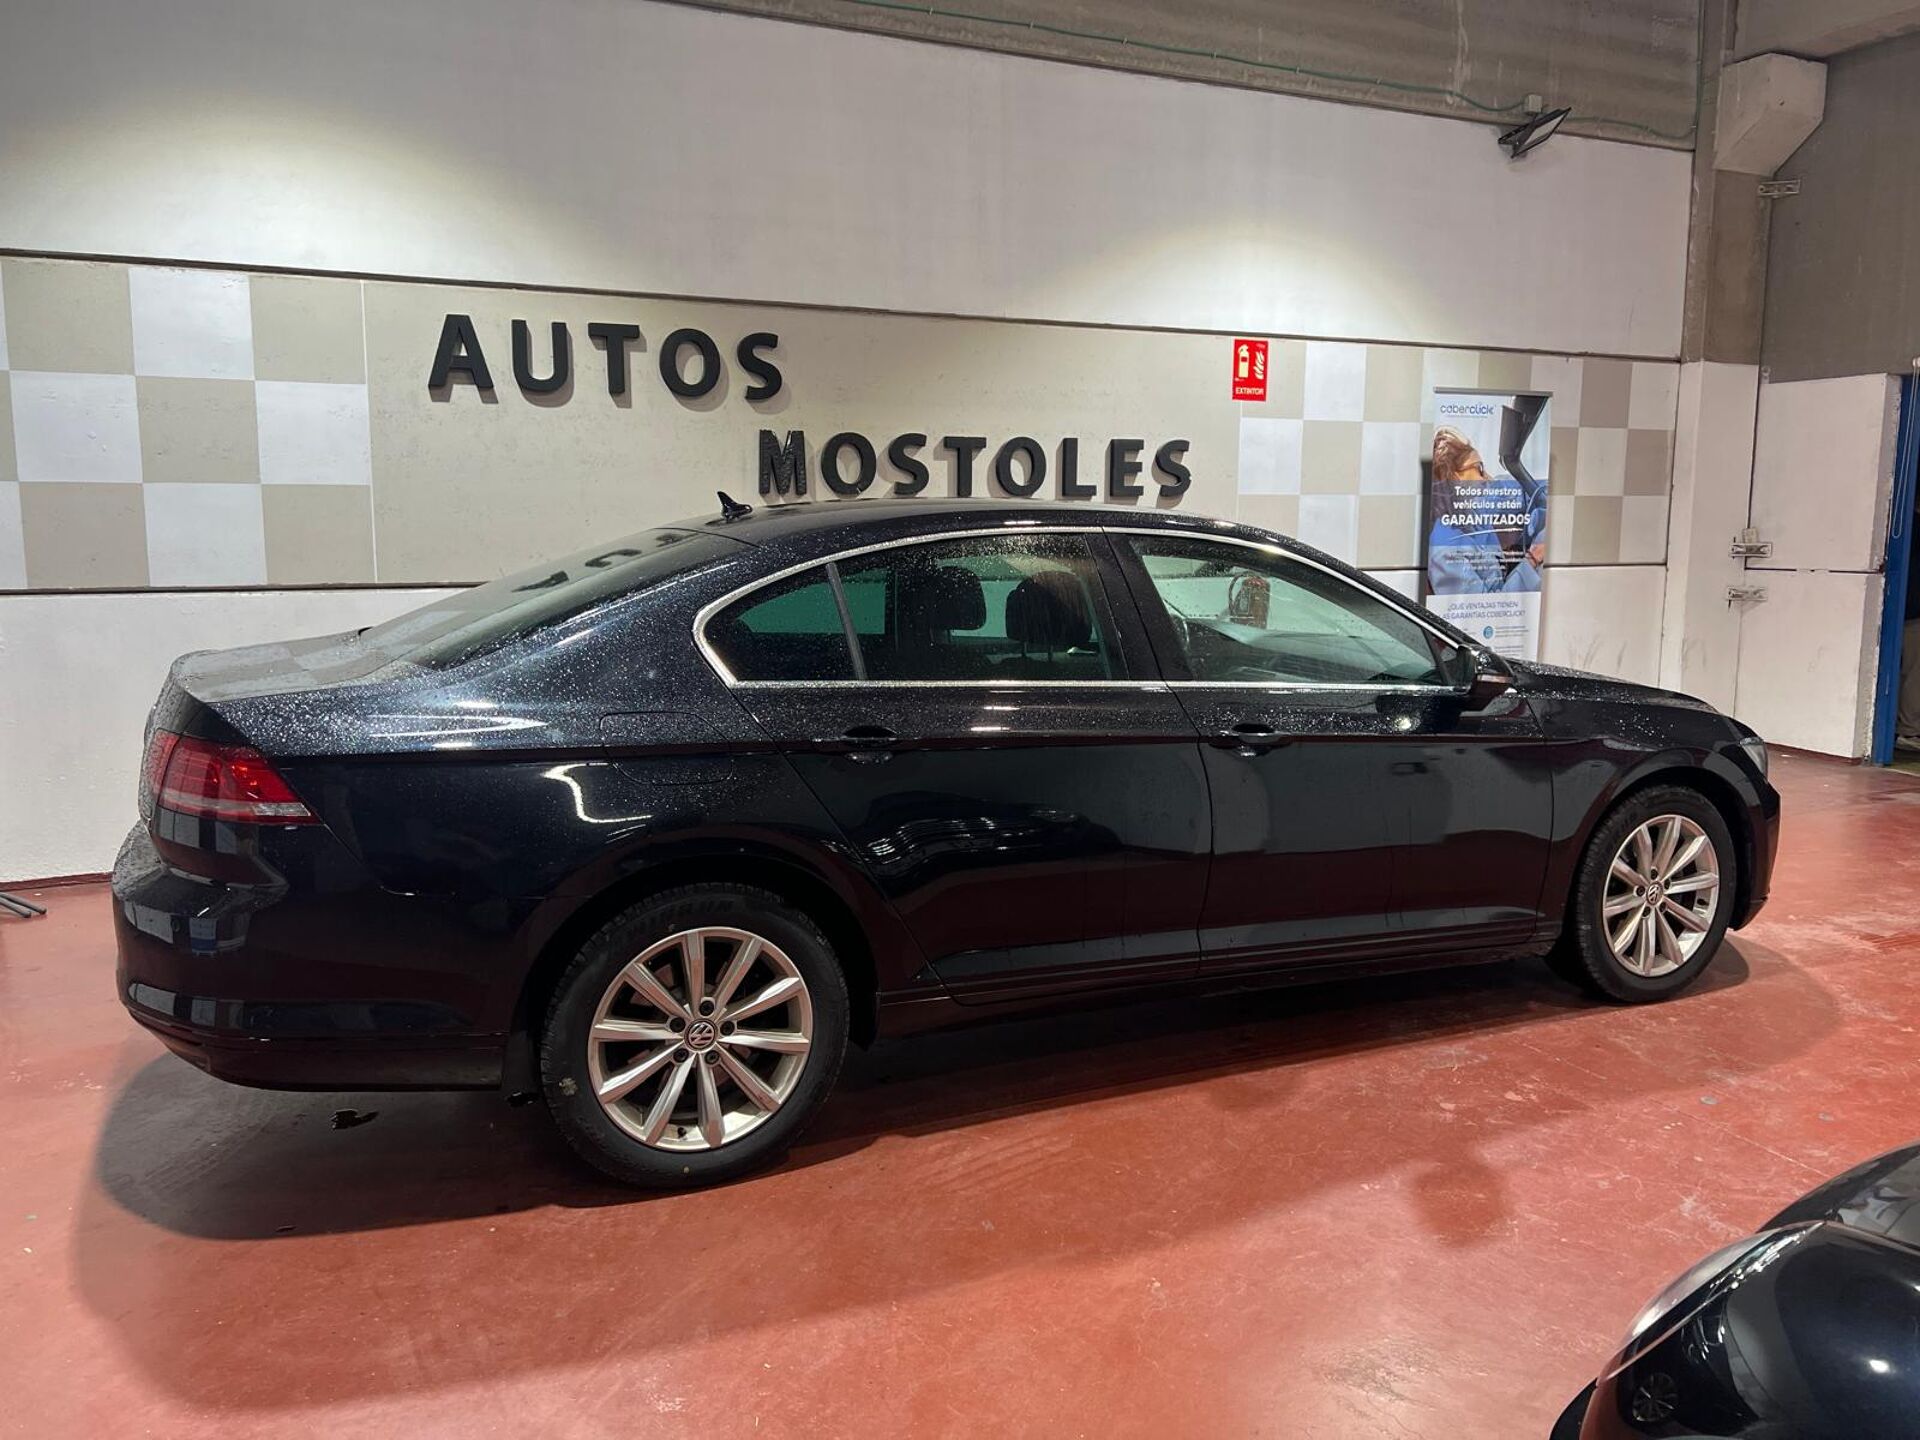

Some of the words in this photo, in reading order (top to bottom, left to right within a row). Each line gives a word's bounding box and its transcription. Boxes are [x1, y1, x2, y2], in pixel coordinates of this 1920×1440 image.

[428, 314, 783, 400] AUTOS
[758, 429, 1192, 498] MOSTOLES
[1454, 486, 1481, 496] Todos
[1482, 486, 1522, 496] nuestros
[1453, 499, 1495, 510] vehículos
[1496, 499, 1522, 509] están
[1441, 513, 1531, 526] GARANTIZADOS
